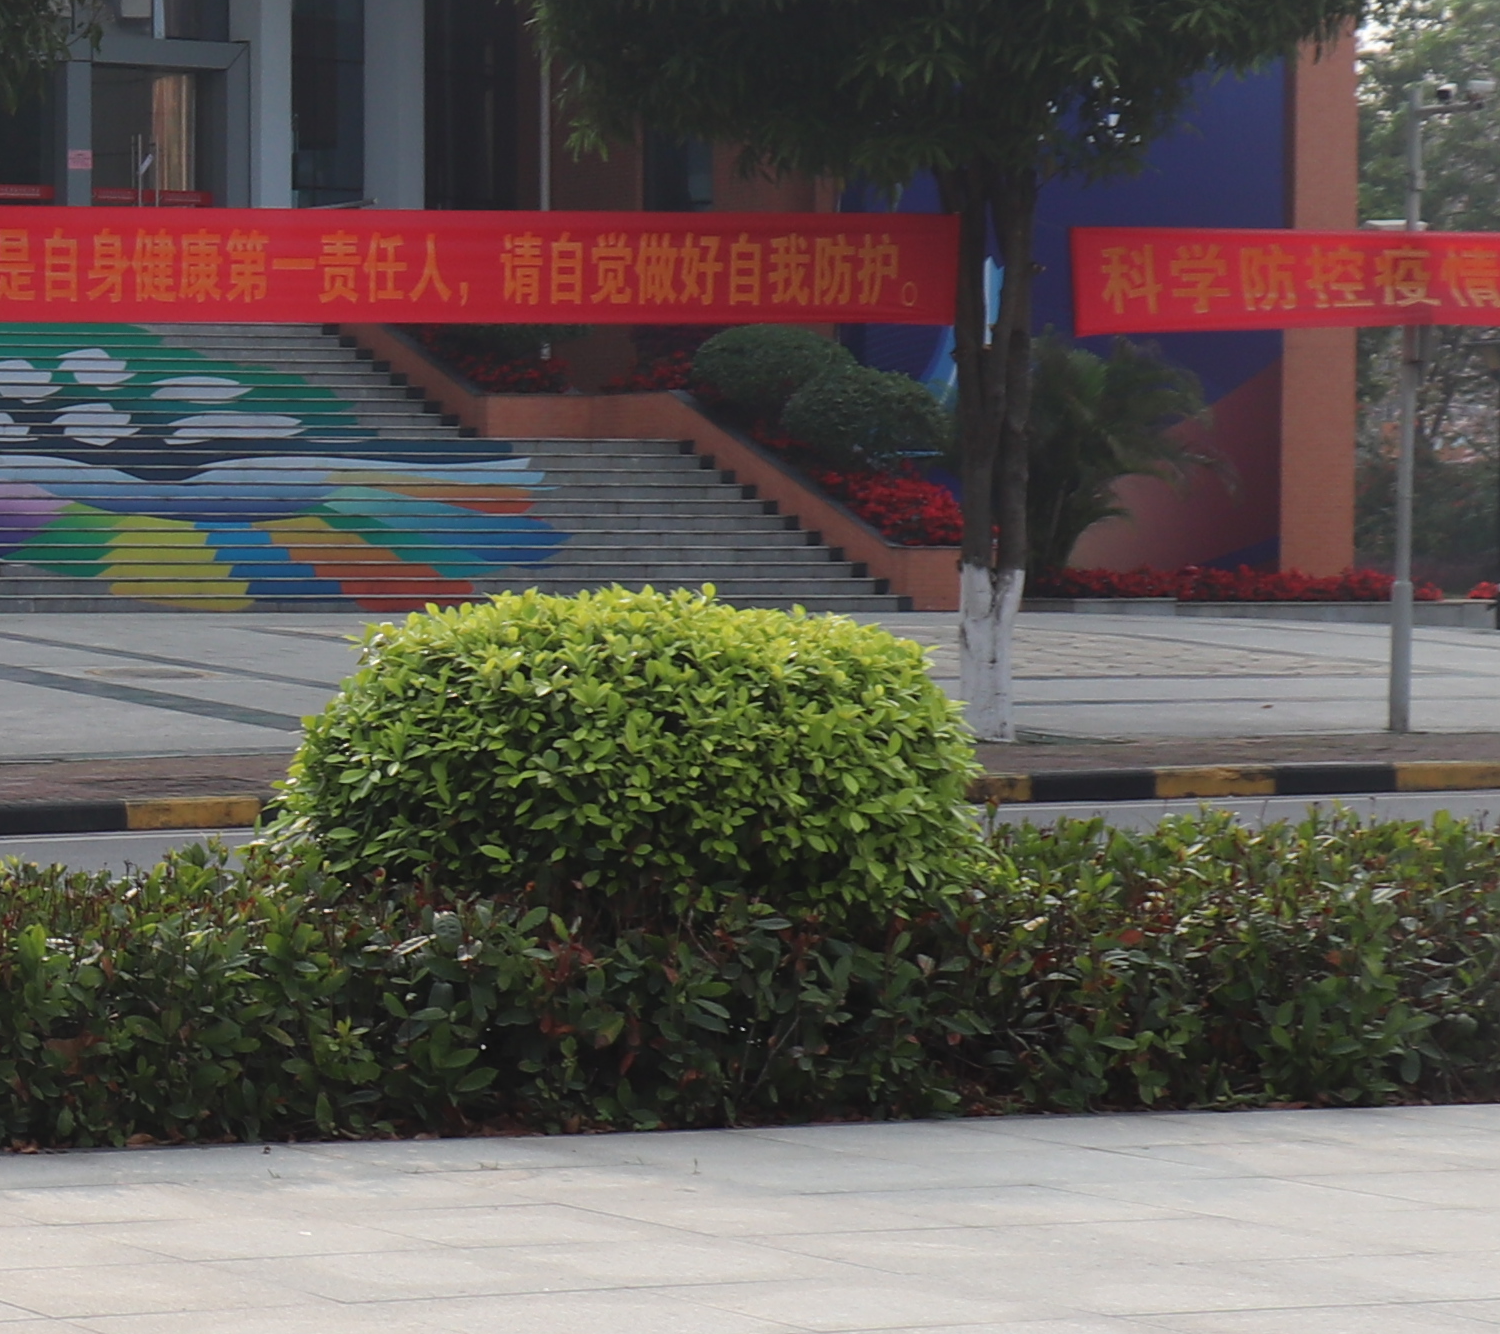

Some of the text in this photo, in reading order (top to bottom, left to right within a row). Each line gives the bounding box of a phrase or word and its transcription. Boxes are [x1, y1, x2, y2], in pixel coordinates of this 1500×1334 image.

[1102, 243, 1500, 314] 科学防控疫情
